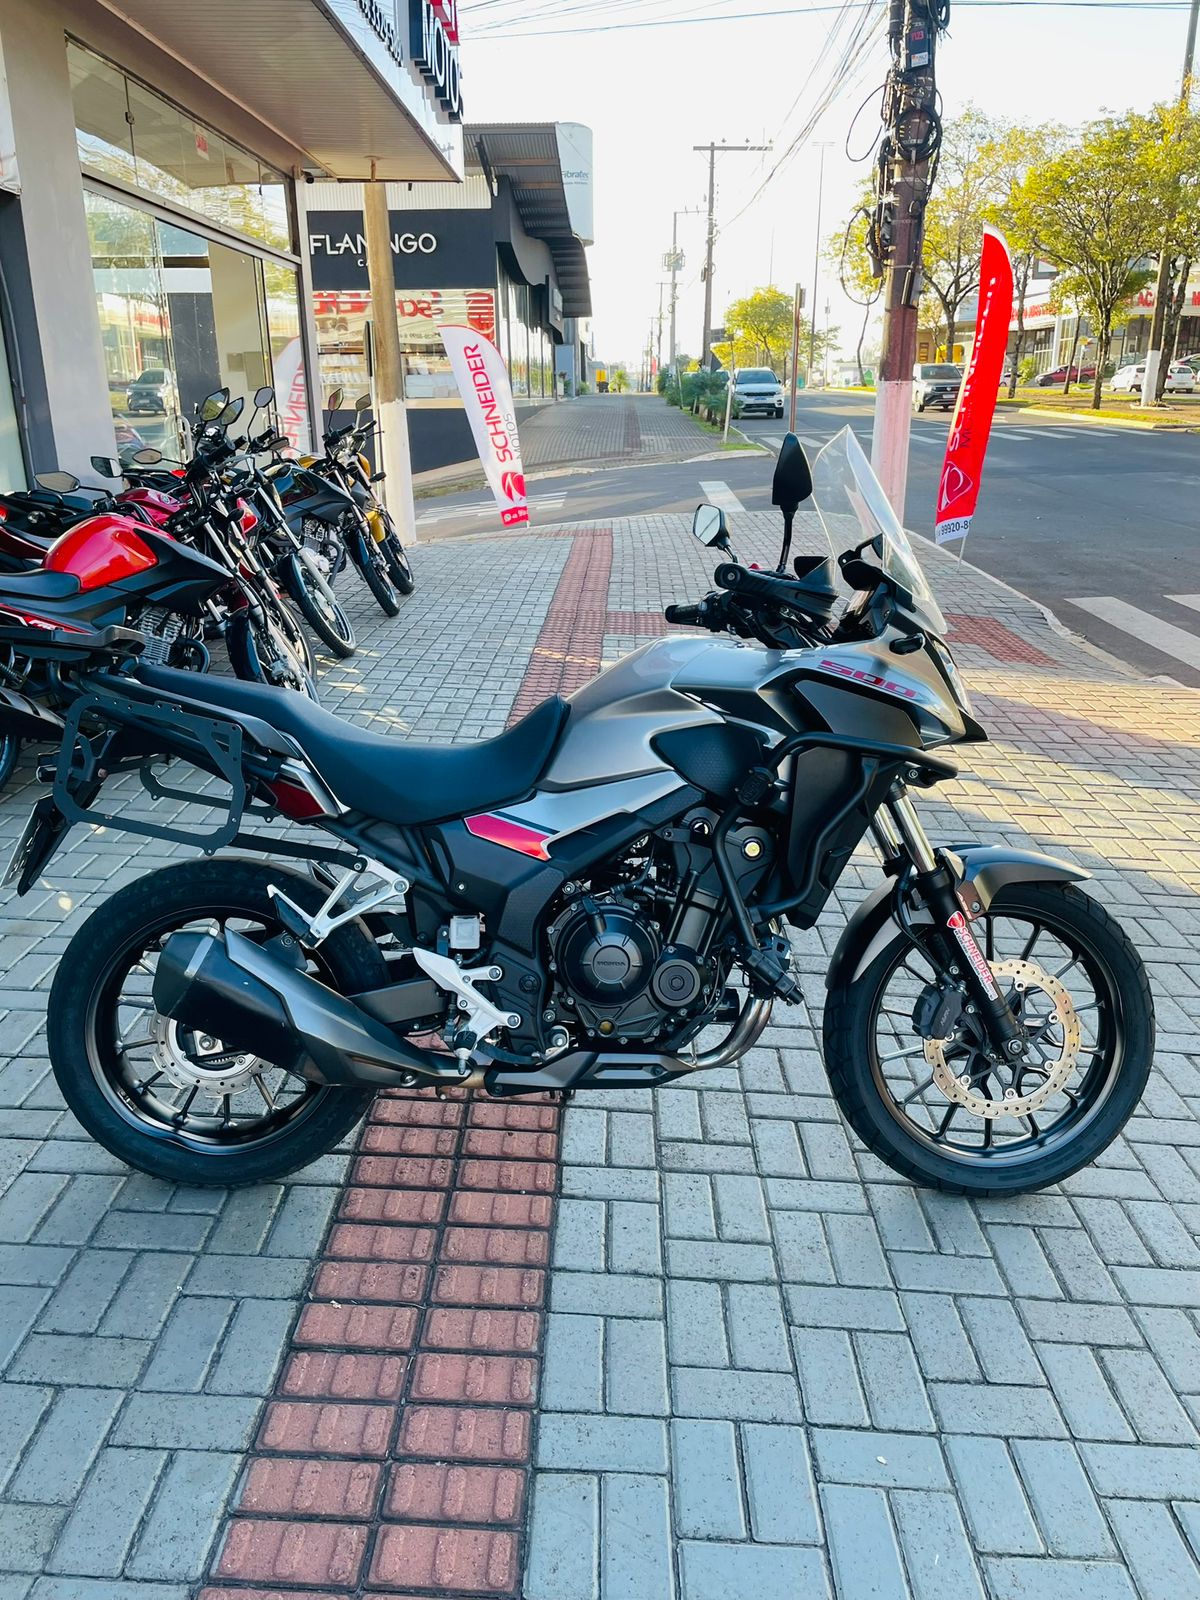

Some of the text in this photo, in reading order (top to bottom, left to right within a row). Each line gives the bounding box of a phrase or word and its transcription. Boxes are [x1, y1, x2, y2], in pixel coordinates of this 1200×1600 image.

[309, 233, 437, 255] FLANGO
[464, 343, 513, 463] SCHNEIDER
[817, 659, 917, 699] 500
[959, 926, 994, 984] SCHNEIDER
